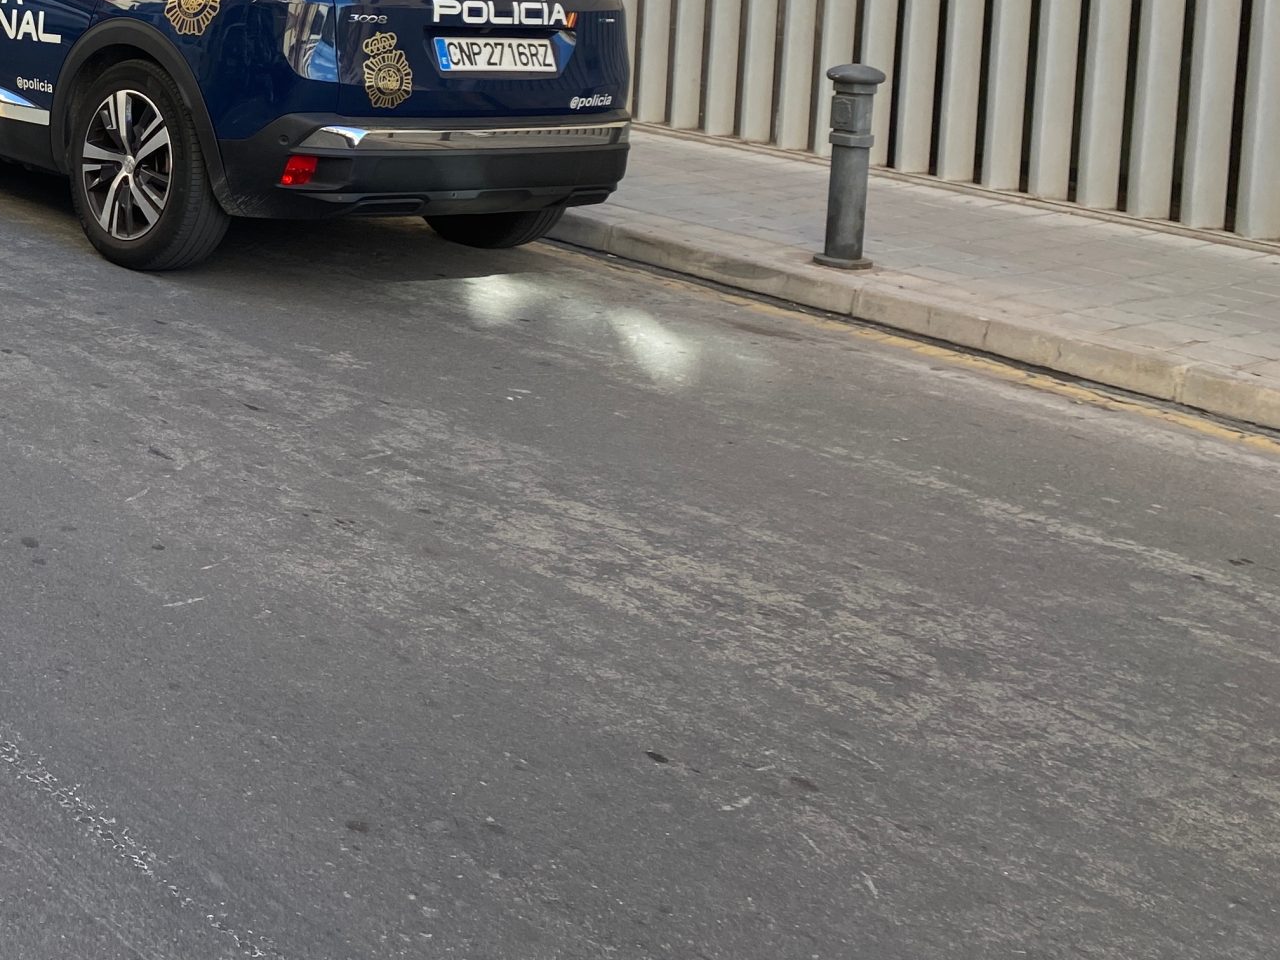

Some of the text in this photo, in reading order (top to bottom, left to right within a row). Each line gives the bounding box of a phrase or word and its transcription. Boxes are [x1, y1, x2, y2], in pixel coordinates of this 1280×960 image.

[347, 14, 388, 24] 3008
[16, 76, 53, 93] @policia
[570, 93, 613, 110] @policia
